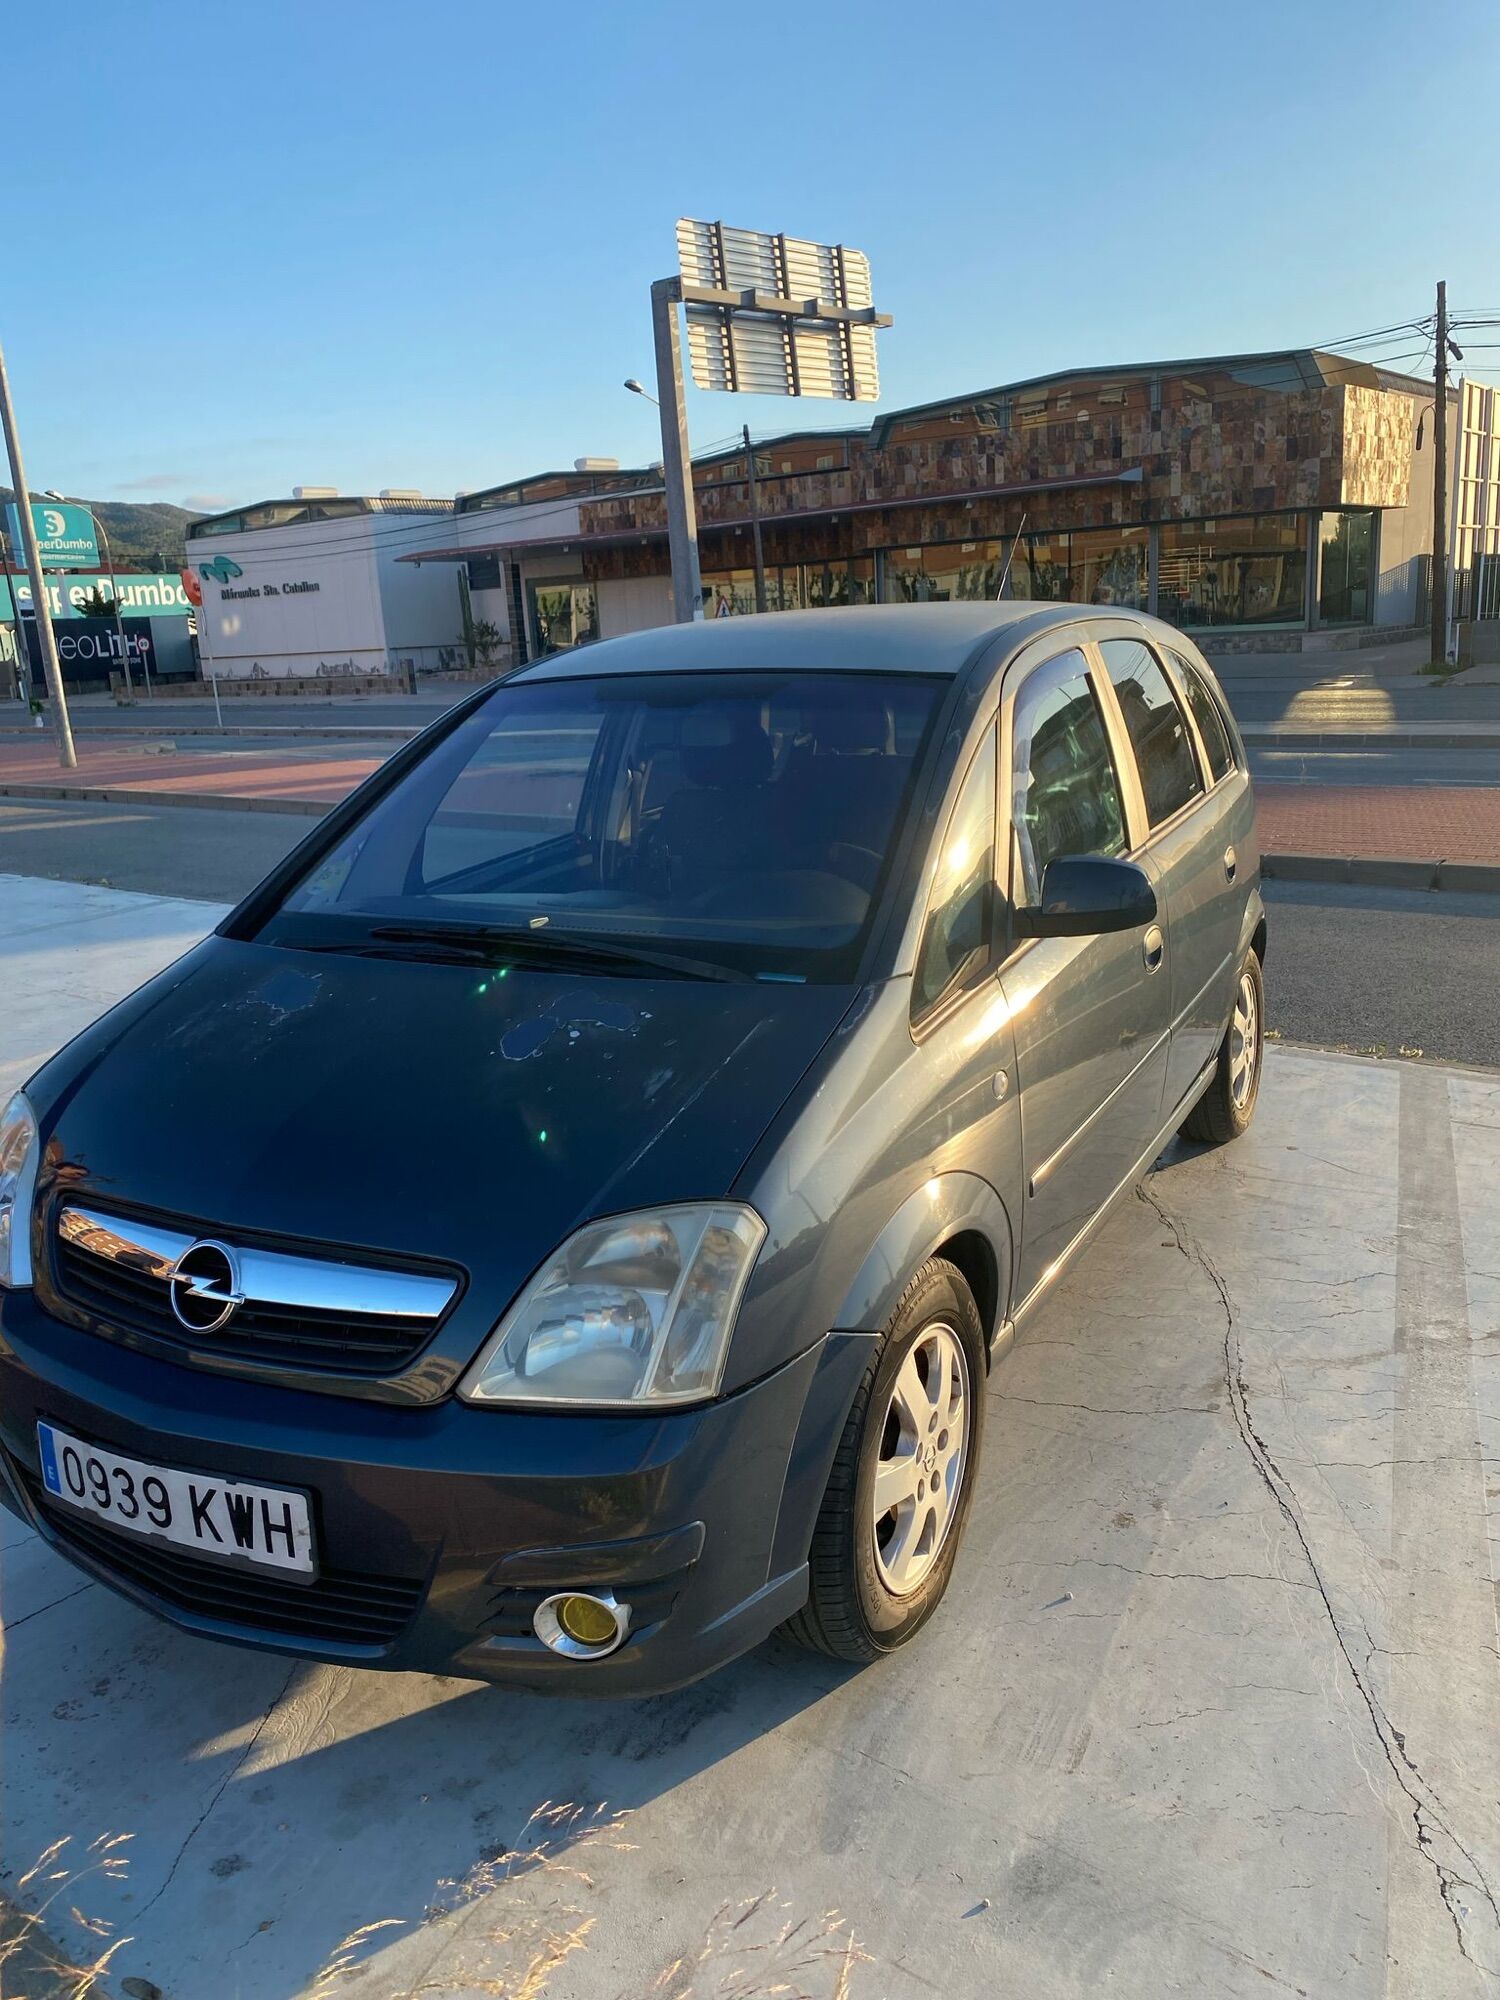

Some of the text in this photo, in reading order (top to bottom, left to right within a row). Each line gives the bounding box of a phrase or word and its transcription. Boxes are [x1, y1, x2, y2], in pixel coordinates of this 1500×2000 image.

[38, 538, 93, 550] perDumbo
[62, 1446, 296, 1559] 0939 KWH
